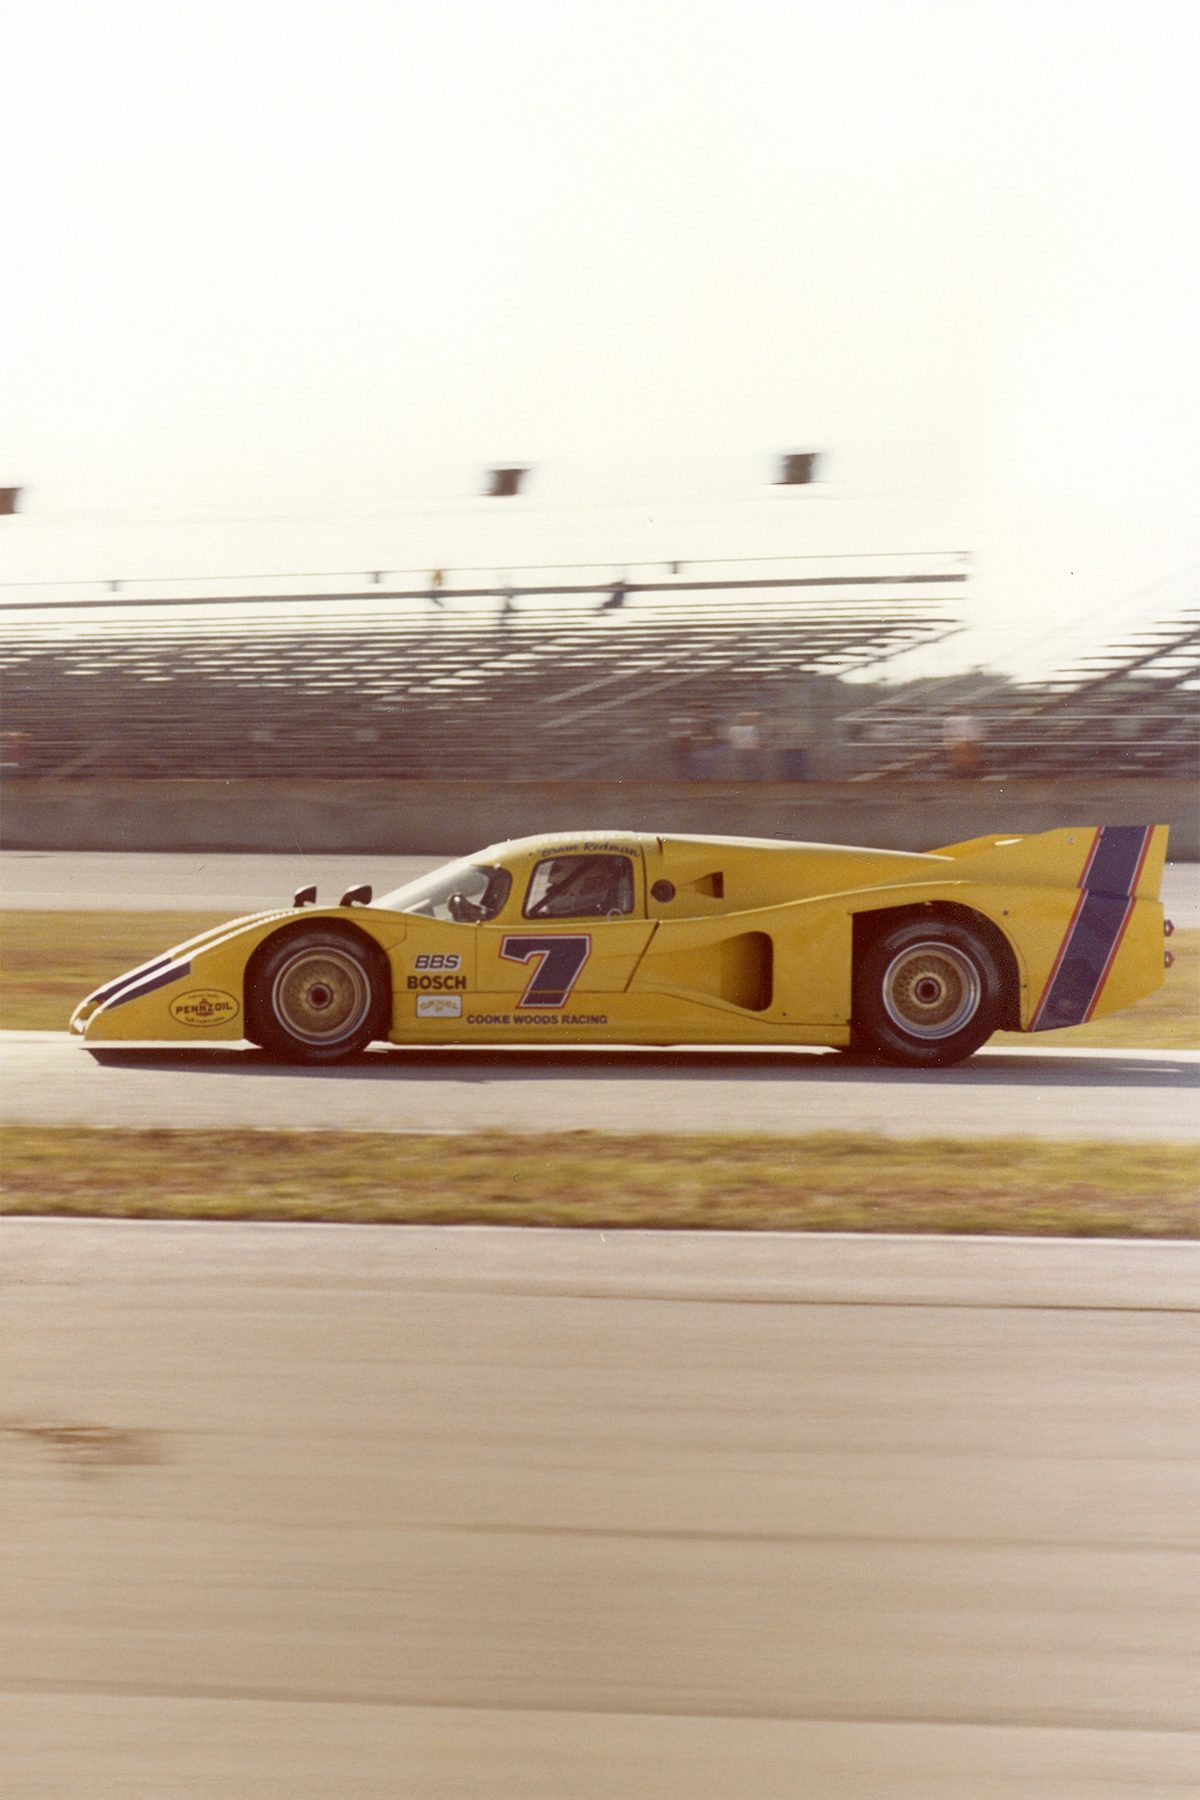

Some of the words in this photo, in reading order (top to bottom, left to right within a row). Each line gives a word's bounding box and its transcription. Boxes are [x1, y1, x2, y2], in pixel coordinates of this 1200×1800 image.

[415, 954, 460, 969] BBS
[499, 933, 592, 1009] 7
[407, 975, 467, 990] BOSCH
[175, 1001, 233, 1015] PENNZOIL
[466, 1014, 510, 1025] COOKE
[513, 1014, 559, 1025] WOODS
[561, 1014, 608, 1025] RACING
